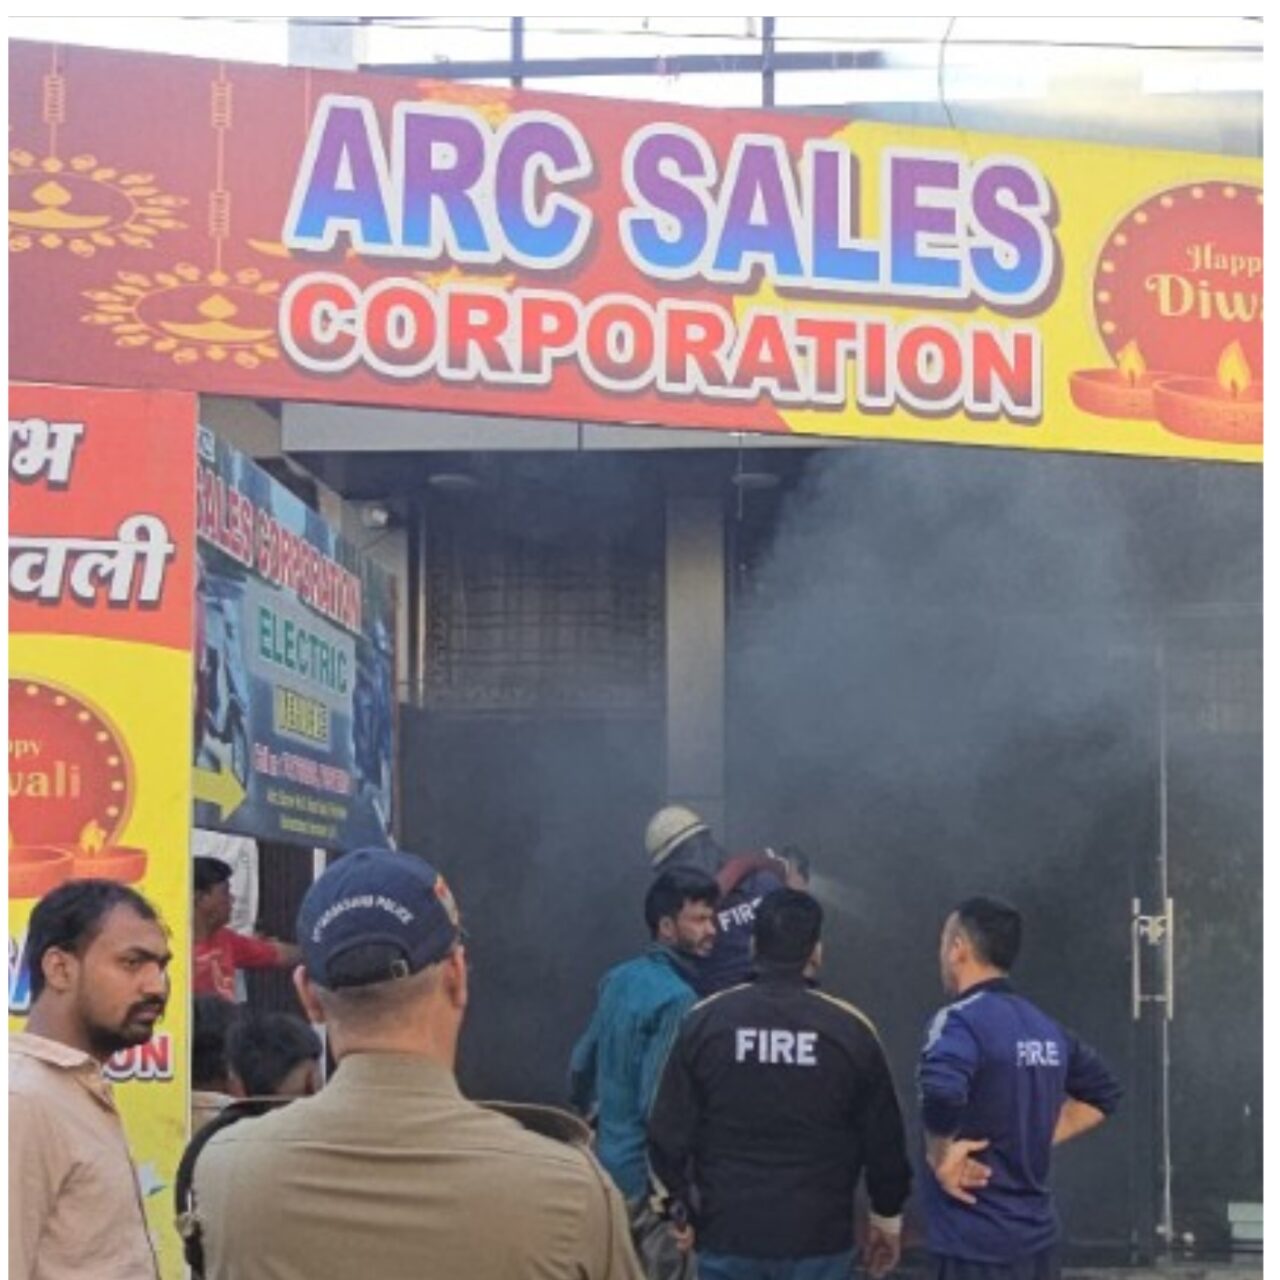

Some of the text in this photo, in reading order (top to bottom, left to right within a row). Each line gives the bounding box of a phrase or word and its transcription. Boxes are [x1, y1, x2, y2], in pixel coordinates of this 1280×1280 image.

[283, 94, 1055, 305] ARC SALES
[1186, 241, 1263, 278] Happ
[1145, 273, 1263, 322] Diw
[278, 273, 1042, 420] CORPORATION
[8, 418, 83, 484] भ
[8, 514, 175, 602] वली
[258, 606, 348, 695] ELECTRIC
[717, 896, 763, 932] FIR
[735, 1027, 818, 1067] FIRE
[1017, 1040, 1061, 1067] FIRE
